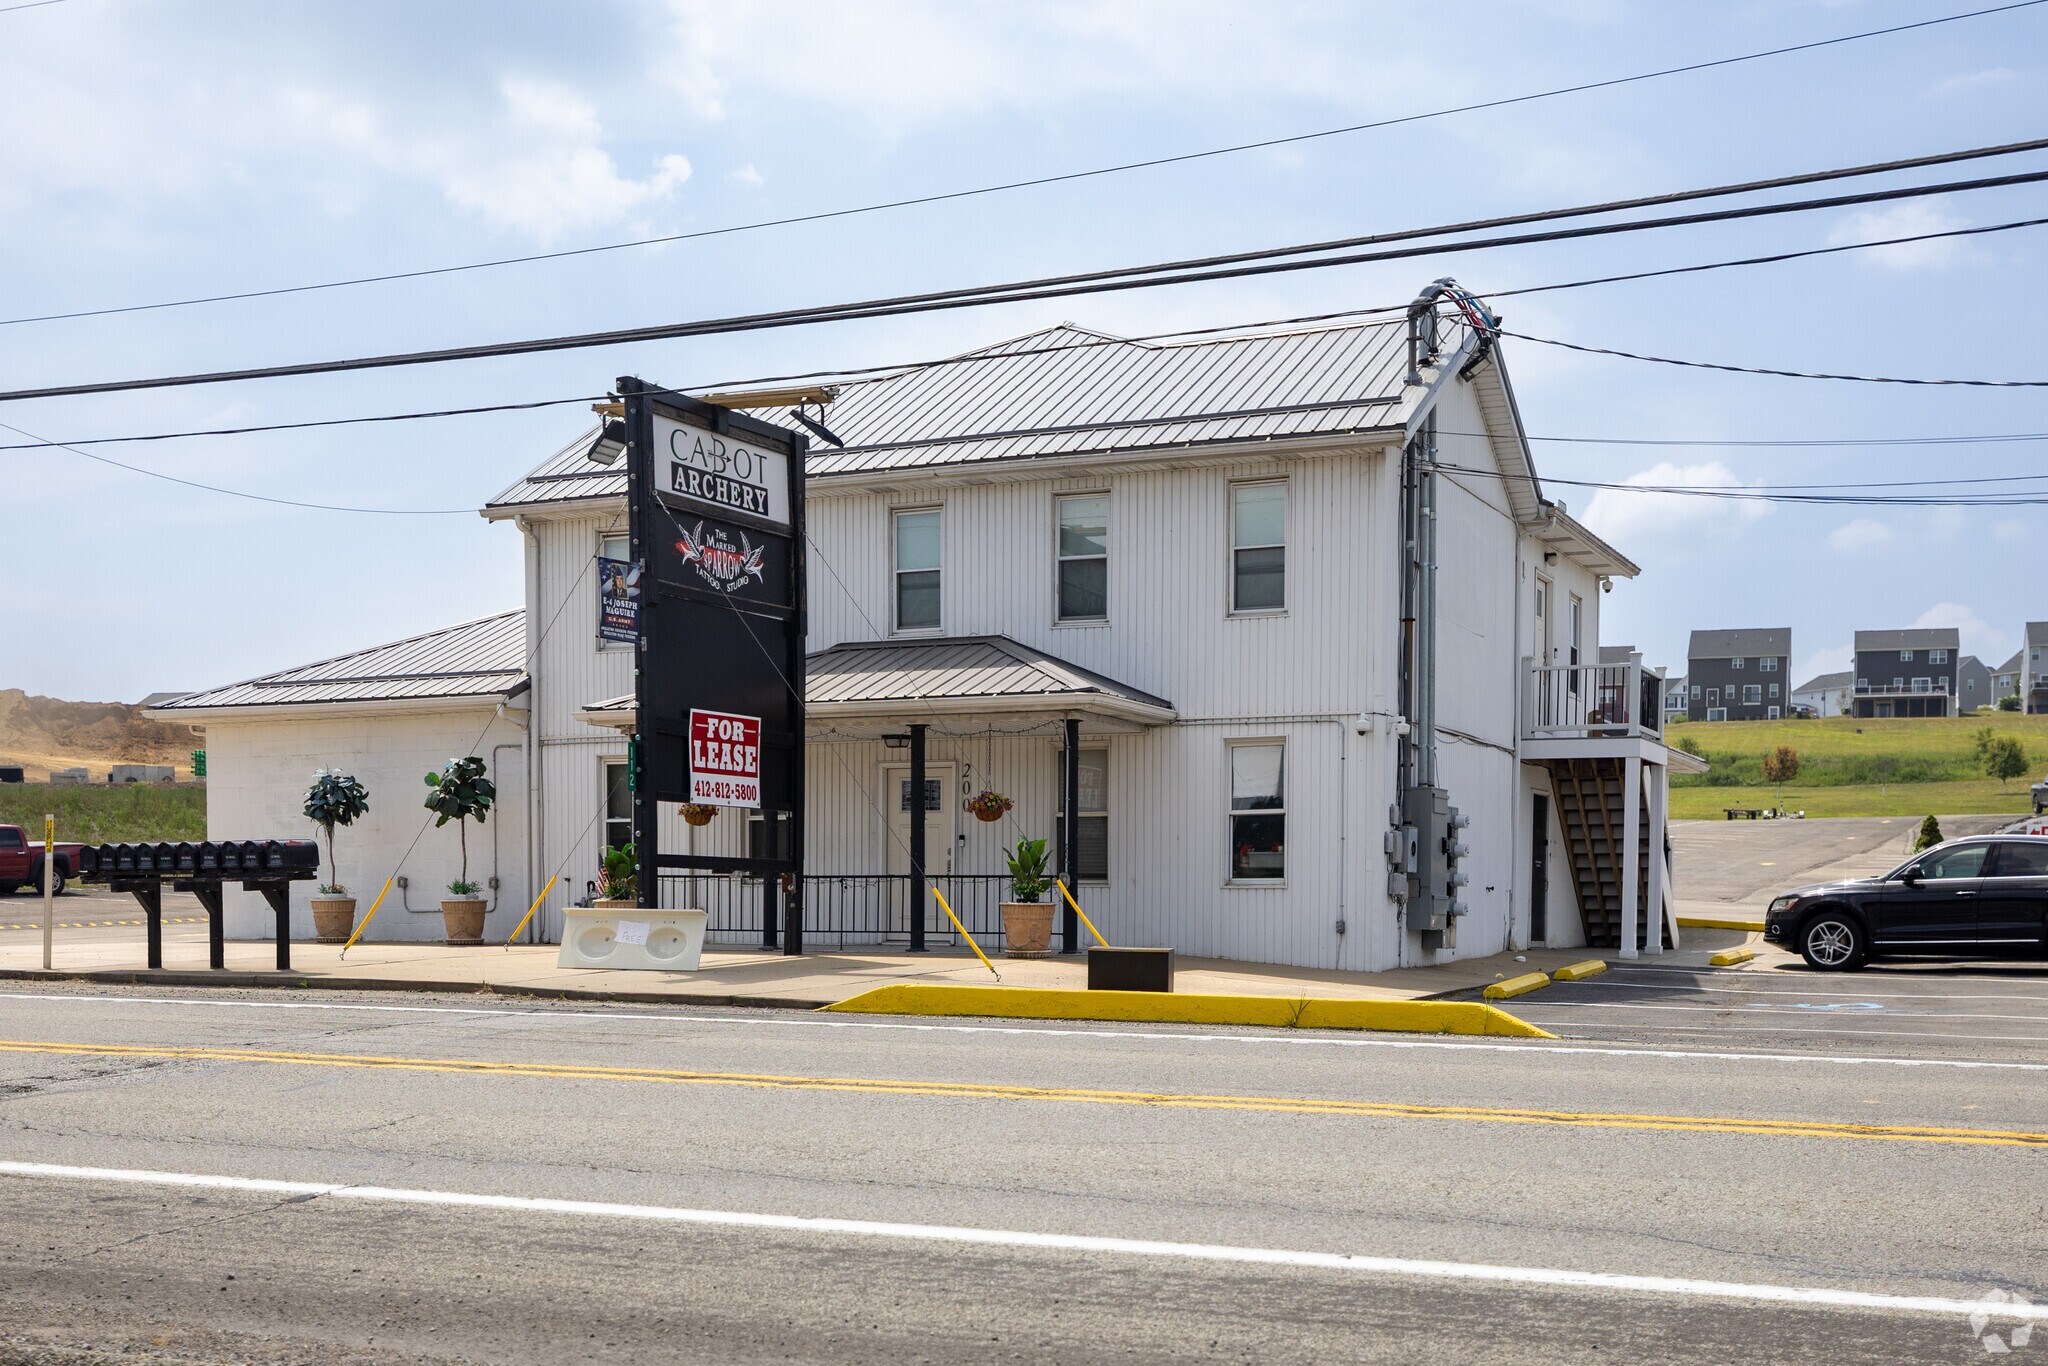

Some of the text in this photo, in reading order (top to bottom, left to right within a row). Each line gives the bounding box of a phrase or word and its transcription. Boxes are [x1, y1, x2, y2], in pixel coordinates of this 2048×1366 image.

[670, 429, 767, 484] CABOT
[674, 466, 767, 513] ARCHERY
[706, 534, 737, 553] MARKED
[715, 528, 728, 541] THE
[695, 563, 749, 592] TATTOO STUDIO
[703, 550, 741, 580] SPARROW
[605, 605, 635, 618] MAGUIRE
[613, 599, 638, 610] JOSEPH
[707, 717, 745, 742] FOR
[693, 739, 757, 773] LEASE
[962, 763, 971, 813] 200
[621, 931, 642, 944] FREE
